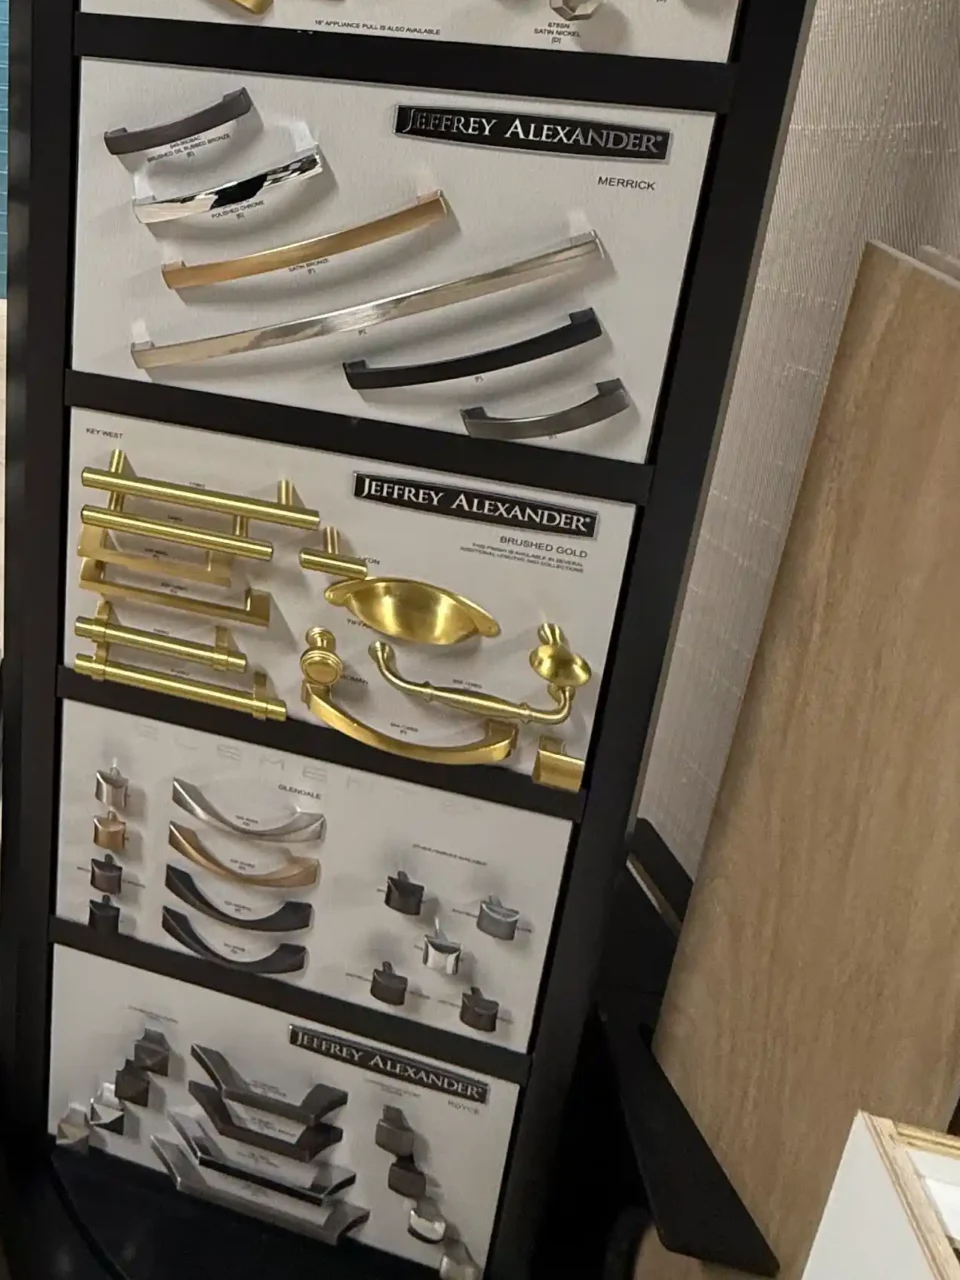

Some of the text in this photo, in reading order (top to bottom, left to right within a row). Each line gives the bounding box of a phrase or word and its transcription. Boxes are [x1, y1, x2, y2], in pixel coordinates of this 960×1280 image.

[324, 20, 360, 29] APPLIANCE
[361, 23, 378, 31] PULL
[386, 25, 405, 33] ALSO
[405, 27, 441, 36] AVAILABLE
[534, 28, 581, 38] SATIN NICKEL
[402, 108, 659, 154] JEFFREY ALEXANDER
[597, 175, 656, 191] MERRICK
[85, 427, 124, 440] KEY WEST
[361, 476, 587, 533] JEFFREY ALEXANDER
[499, 535, 588, 559] BRUSHED GOLD
[277, 783, 323, 801] GLENDALE
[296, 1031, 364, 1062] JEFFREY
[369, 1054, 480, 1099] ALEXANDER
